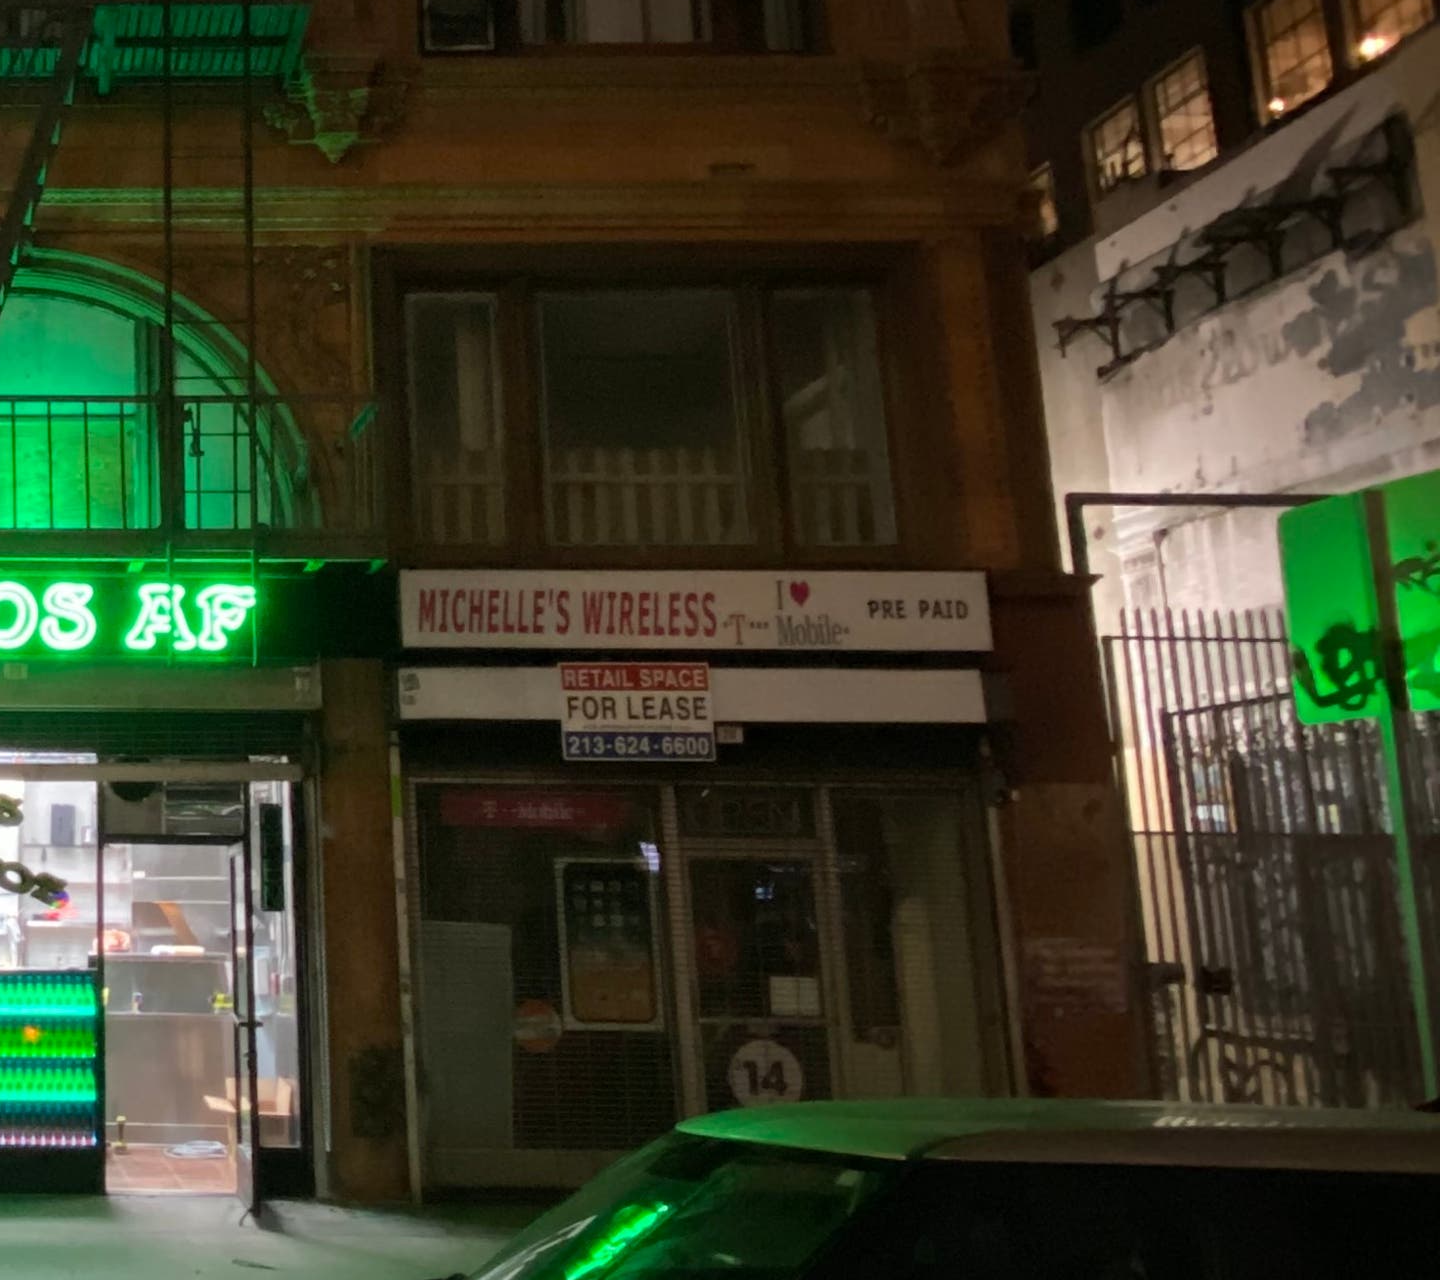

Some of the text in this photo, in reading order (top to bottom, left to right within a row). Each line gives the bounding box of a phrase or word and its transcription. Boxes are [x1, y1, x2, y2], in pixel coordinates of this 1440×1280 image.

[124, 583, 256, 650] AF
[418, 588, 717, 637] MICHELLE'S WIRELESS
[867, 600, 969, 620] PRE PAID
[564, 669, 706, 688] RETAIL SPACE
[567, 696, 707, 720] FOR LEASE
[745, 1060, 788, 1097] 14
